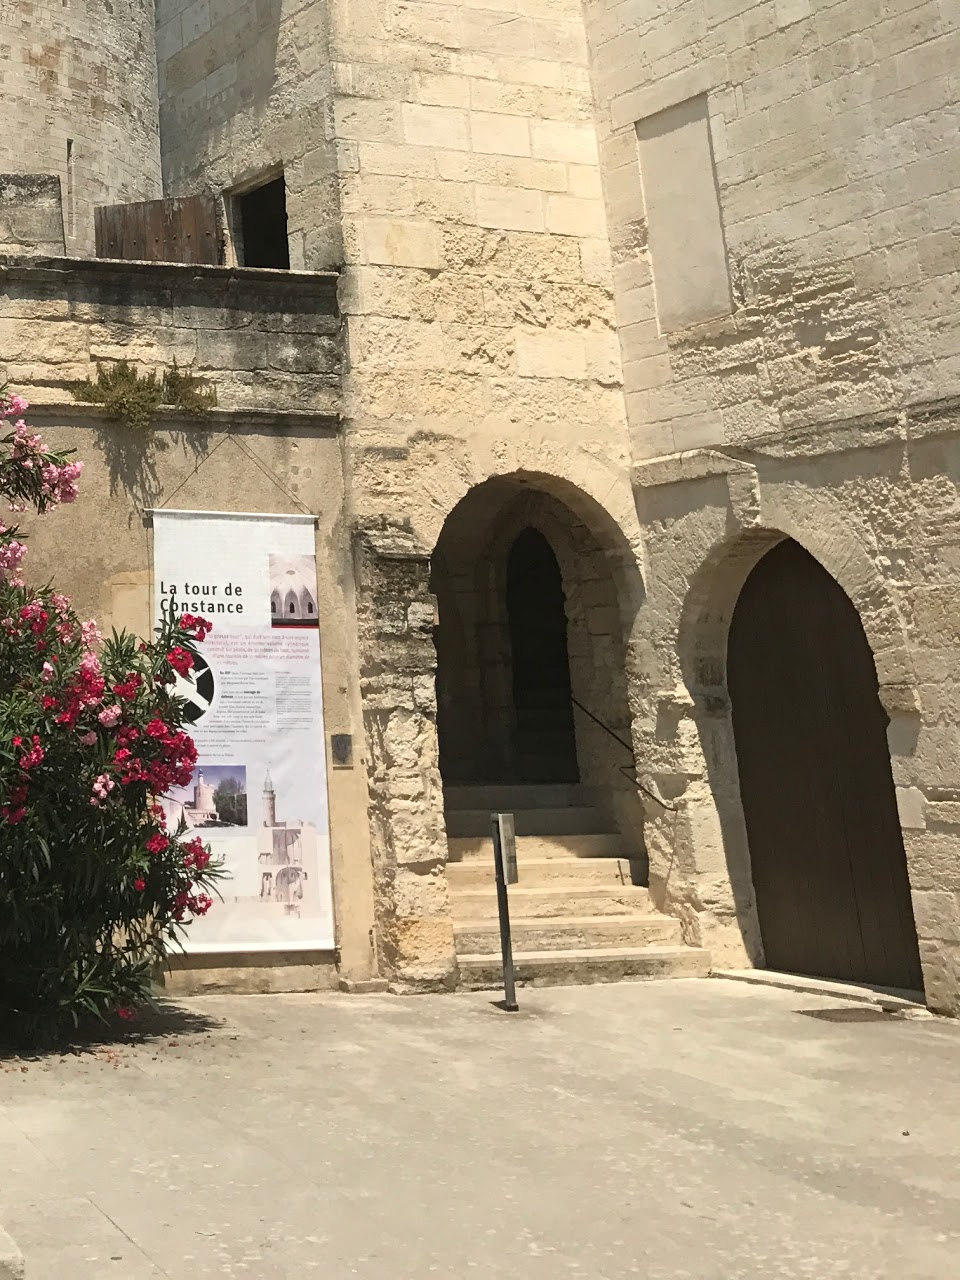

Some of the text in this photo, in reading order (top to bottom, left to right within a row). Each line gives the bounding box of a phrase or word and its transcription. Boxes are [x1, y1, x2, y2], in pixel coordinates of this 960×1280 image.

[160, 581, 243, 596] La tour de
[160, 598, 243, 614] Constance
